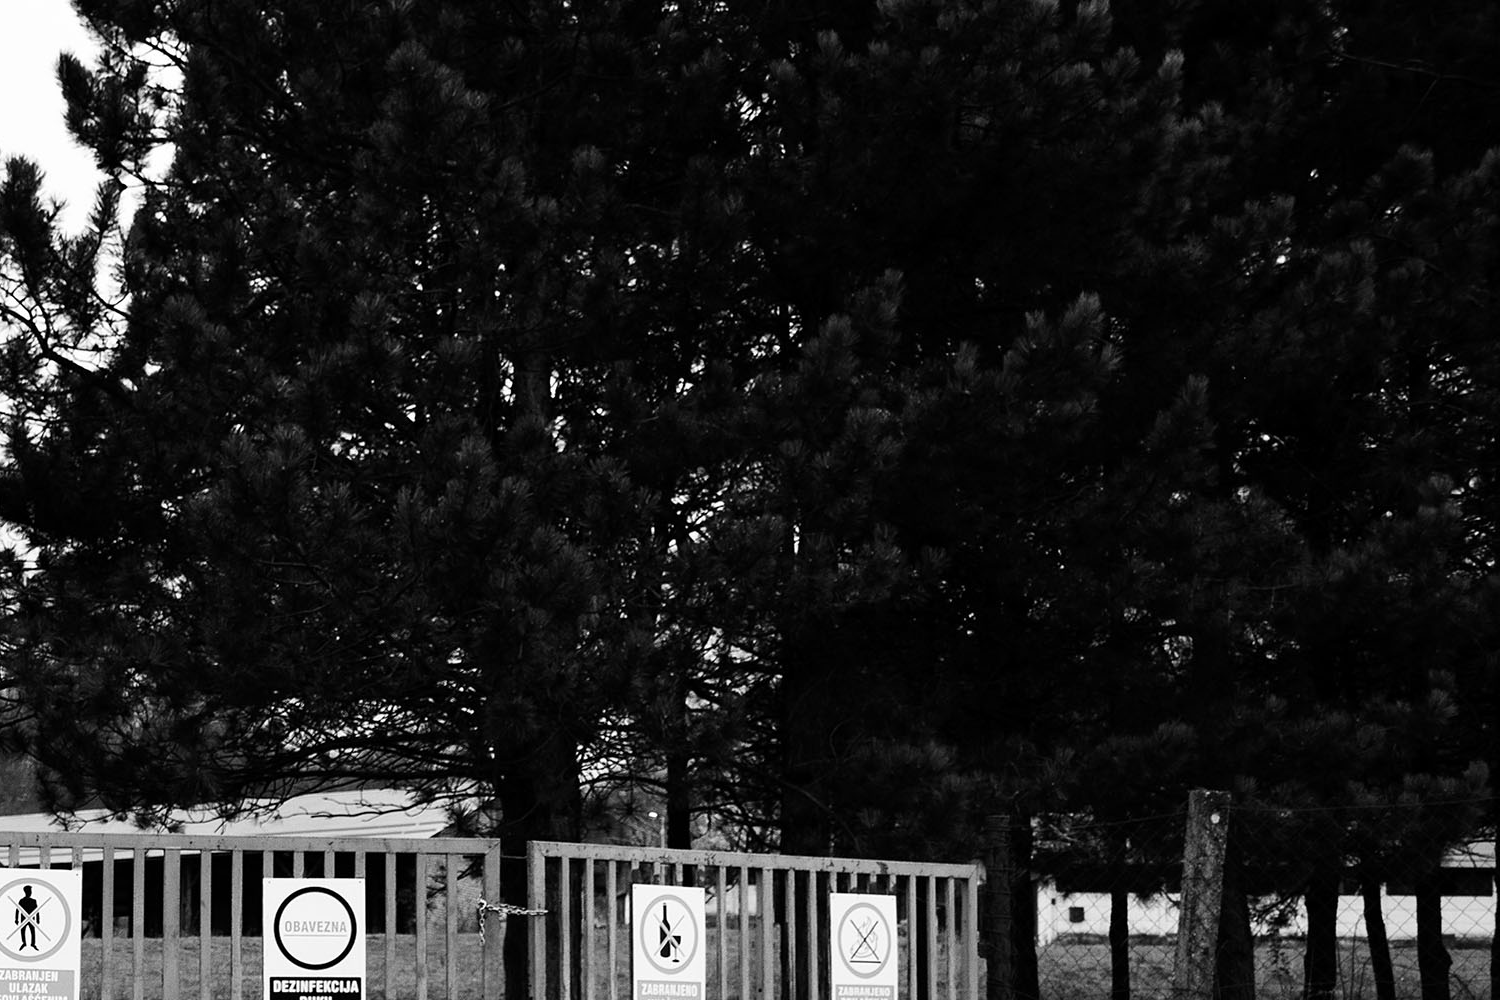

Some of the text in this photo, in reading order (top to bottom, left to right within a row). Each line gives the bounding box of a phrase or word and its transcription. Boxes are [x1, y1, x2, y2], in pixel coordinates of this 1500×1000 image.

[285, 921, 347, 933] OBAVEZNA
[8, 982, 48, 993] ULAZAK
[273, 980, 359, 993] DEZINFEKCIJA
[641, 983, 698, 997] ZABRANJENO
[838, 986, 891, 997] ZABRANJENO
